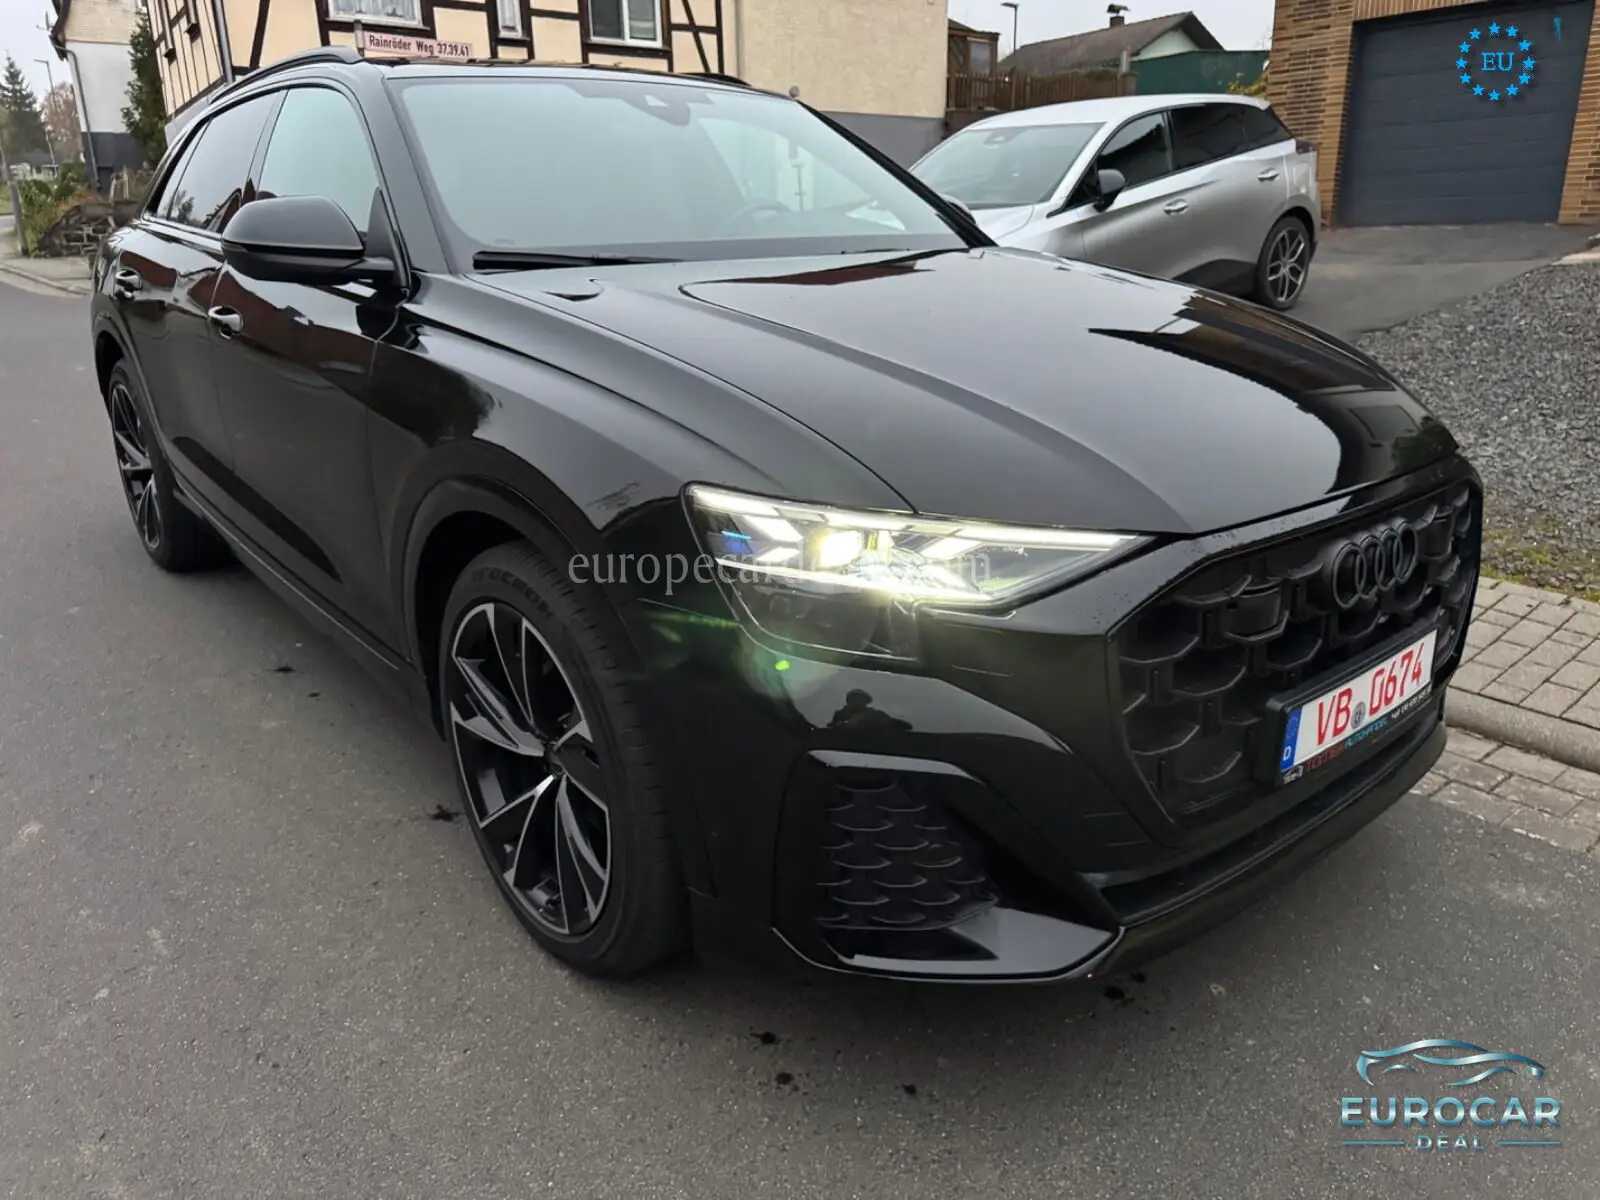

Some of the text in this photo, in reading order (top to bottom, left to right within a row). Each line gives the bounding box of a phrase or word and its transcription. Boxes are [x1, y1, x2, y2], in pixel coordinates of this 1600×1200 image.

[369, 34, 411, 50] Rainröder
[416, 40, 434, 56] Weg
[1317, 687, 1353, 746] VB
[1368, 642, 1425, 716] 0674
[1283, 746, 1291, 761] D
